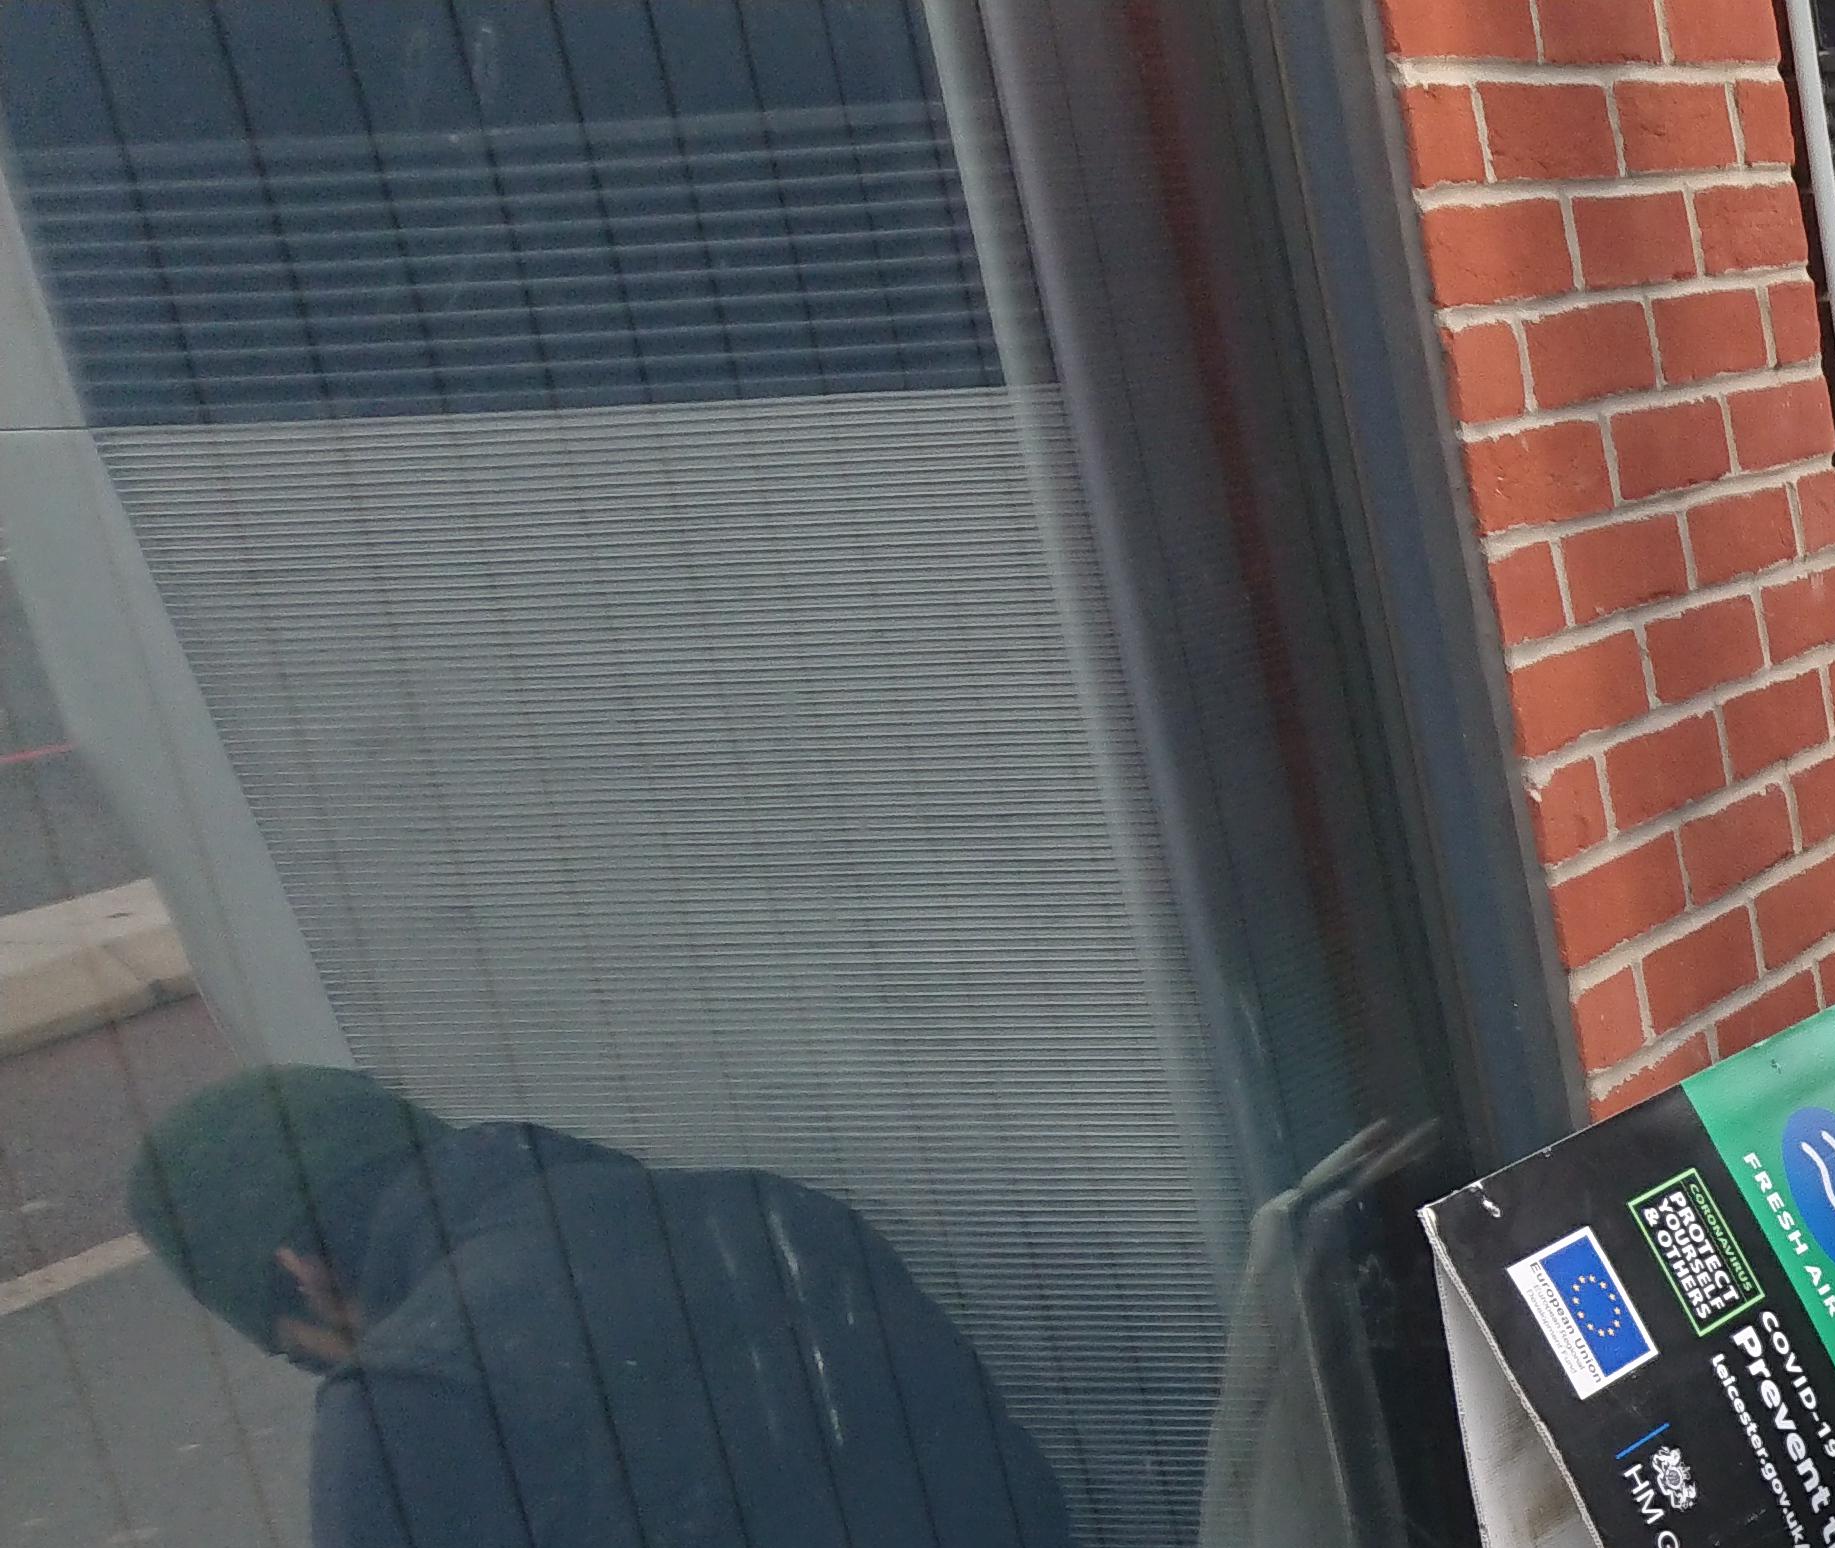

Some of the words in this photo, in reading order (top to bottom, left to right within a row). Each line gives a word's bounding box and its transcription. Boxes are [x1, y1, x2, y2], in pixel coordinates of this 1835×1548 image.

[1658, 1197, 1726, 1310] YOURSELF
[1668, 1191, 1740, 1301] PROTECT
[1690, 1183, 1753, 1292] CORONAVIRUS
[1743, 1151, 1809, 1256] FRESH
[1532, 1284, 1562, 1330] European
[1643, 1206, 1661, 1228] &
[1656, 1229, 1712, 1319] OTHERS
[1529, 1261, 1575, 1335] European
[1574, 1337, 1602, 1384] Union
[1731, 1325, 1831, 1514] Prevent
[1623, 1463, 1665, 1525] HM
